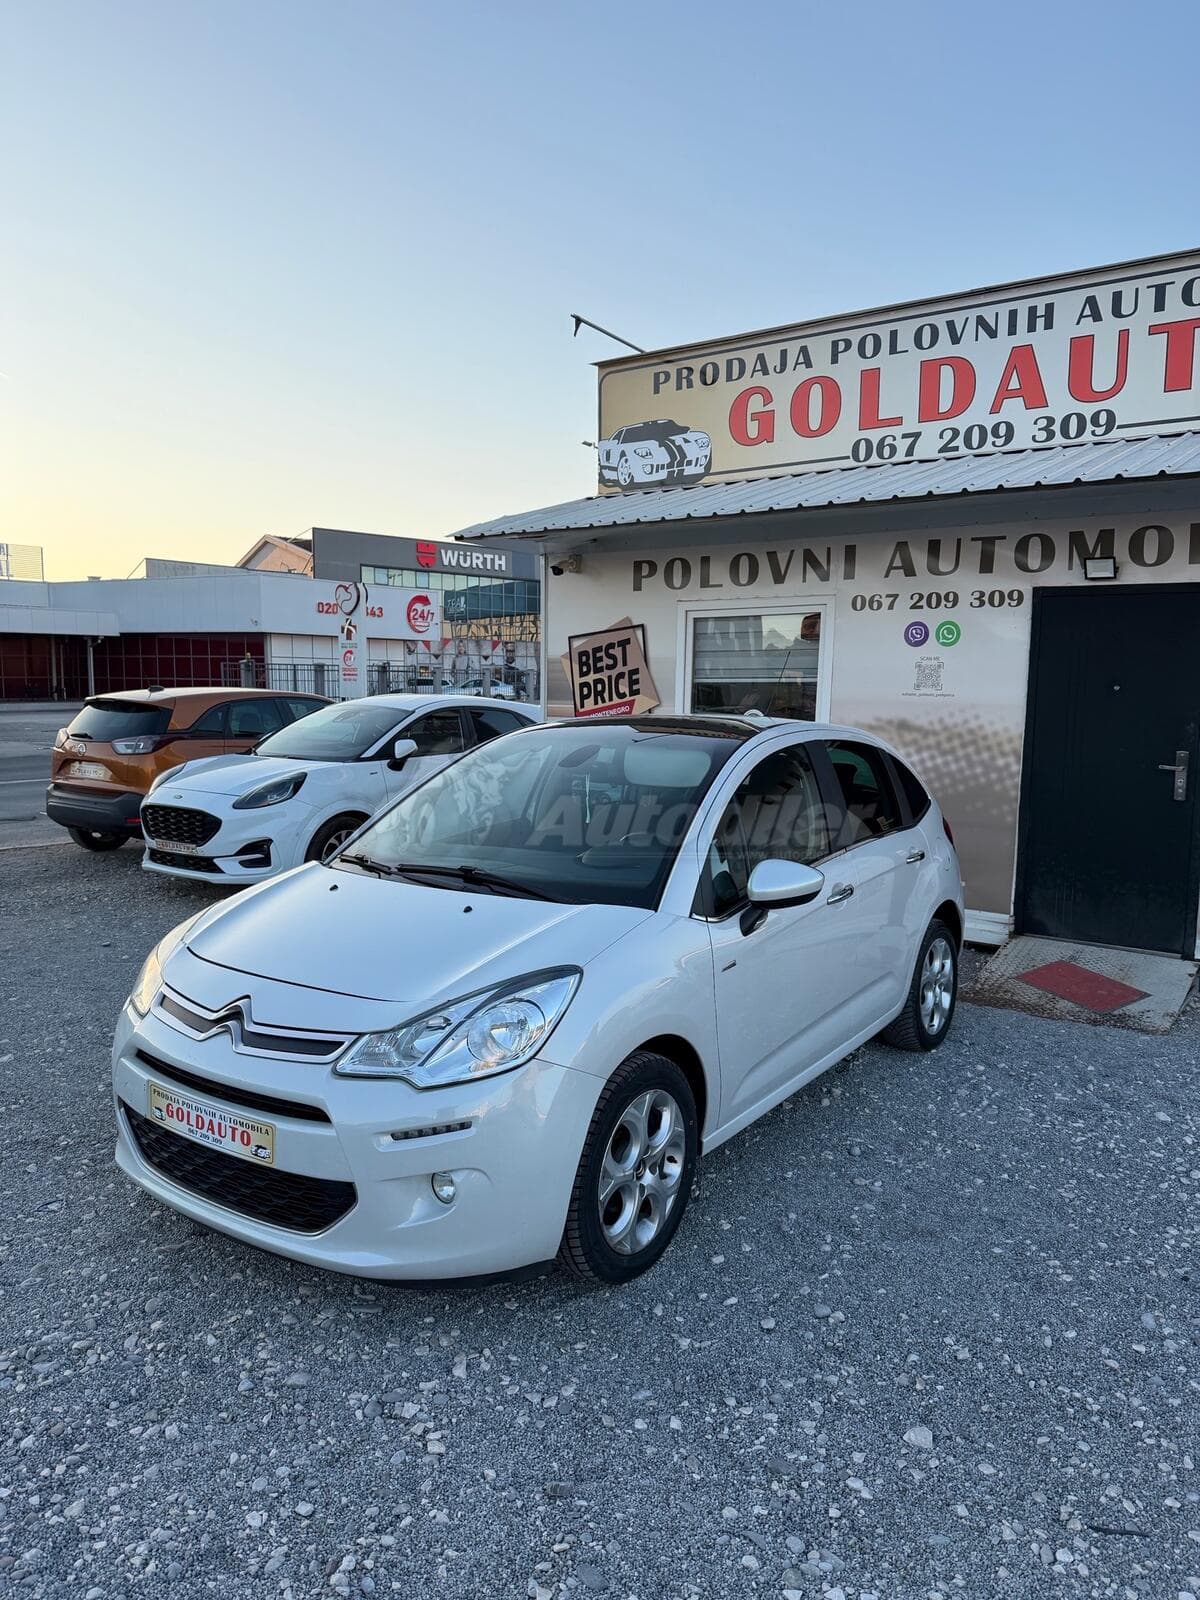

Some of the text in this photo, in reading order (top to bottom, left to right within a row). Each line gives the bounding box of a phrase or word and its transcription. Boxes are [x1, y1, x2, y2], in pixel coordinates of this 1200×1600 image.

[653, 345, 813, 395] PRODAJA
[830, 302, 1055, 365] POLOVNIH
[728, 317, 1200, 447] GOLDAUT
[851, 408, 1117, 463] 067 209 309
[440, 549, 506, 571] WÜRTH
[632, 523, 1200, 592] POLOVNI AUTOMO
[317, 602, 338, 614] 020
[411, 608, 435, 622] 24/7
[851, 589, 1025, 612] 067 209 309
[577, 637, 631, 679] BEST
[578, 667, 641, 710] PRICE
[153, 1088, 270, 1136] PRODAJA POLOVNIH AUTOMOBILA
[165, 1103, 252, 1147] GOLDAUTO
[188, 1128, 222, 1145] 067 209 309
